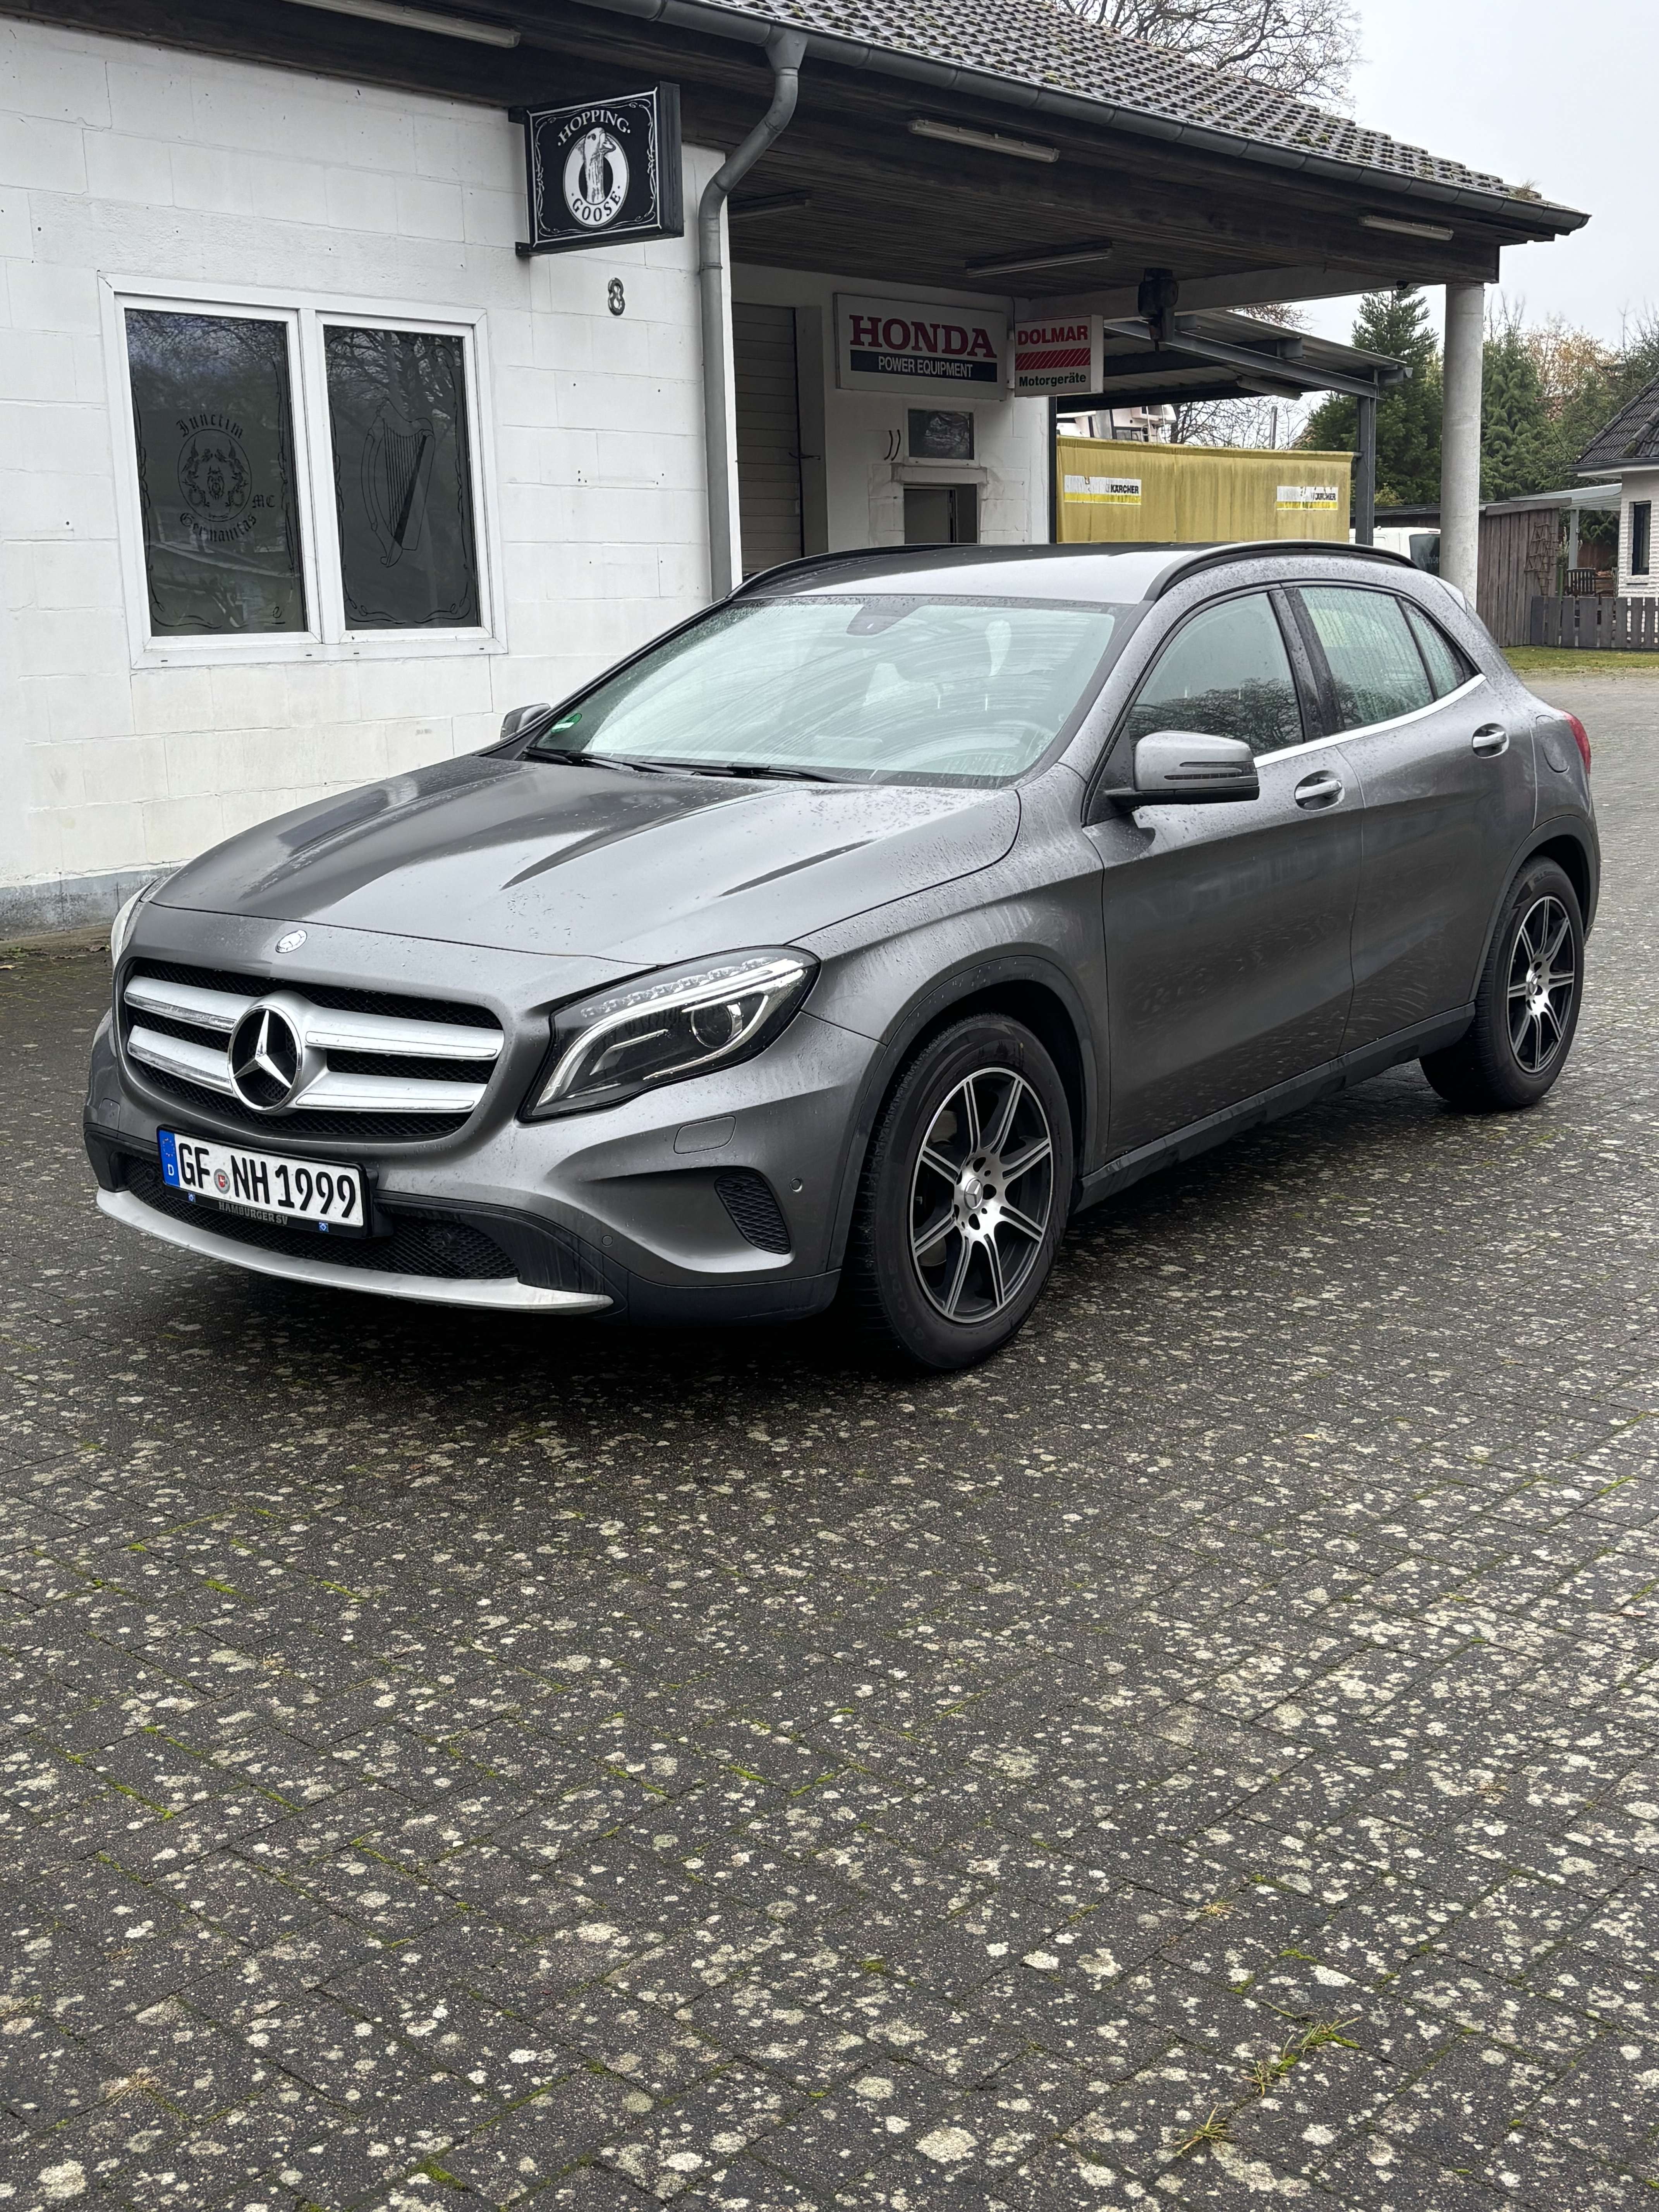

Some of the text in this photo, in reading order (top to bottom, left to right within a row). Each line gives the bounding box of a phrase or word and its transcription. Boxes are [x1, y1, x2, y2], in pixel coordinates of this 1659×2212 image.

[572, 191, 621, 222] GOOSE
[608, 277, 625, 316] 8
[849, 314, 997, 358] HONDA
[1018, 325, 1088, 345] DOLMAR
[878, 356, 973, 378] POWER EQUIPMENT
[1019, 372, 1086, 386] Motorgeräte
[167, 1163, 175, 1176] D
[178, 1142, 210, 1189] GF
[218, 1201, 289, 1225] HAMBURGER SV
